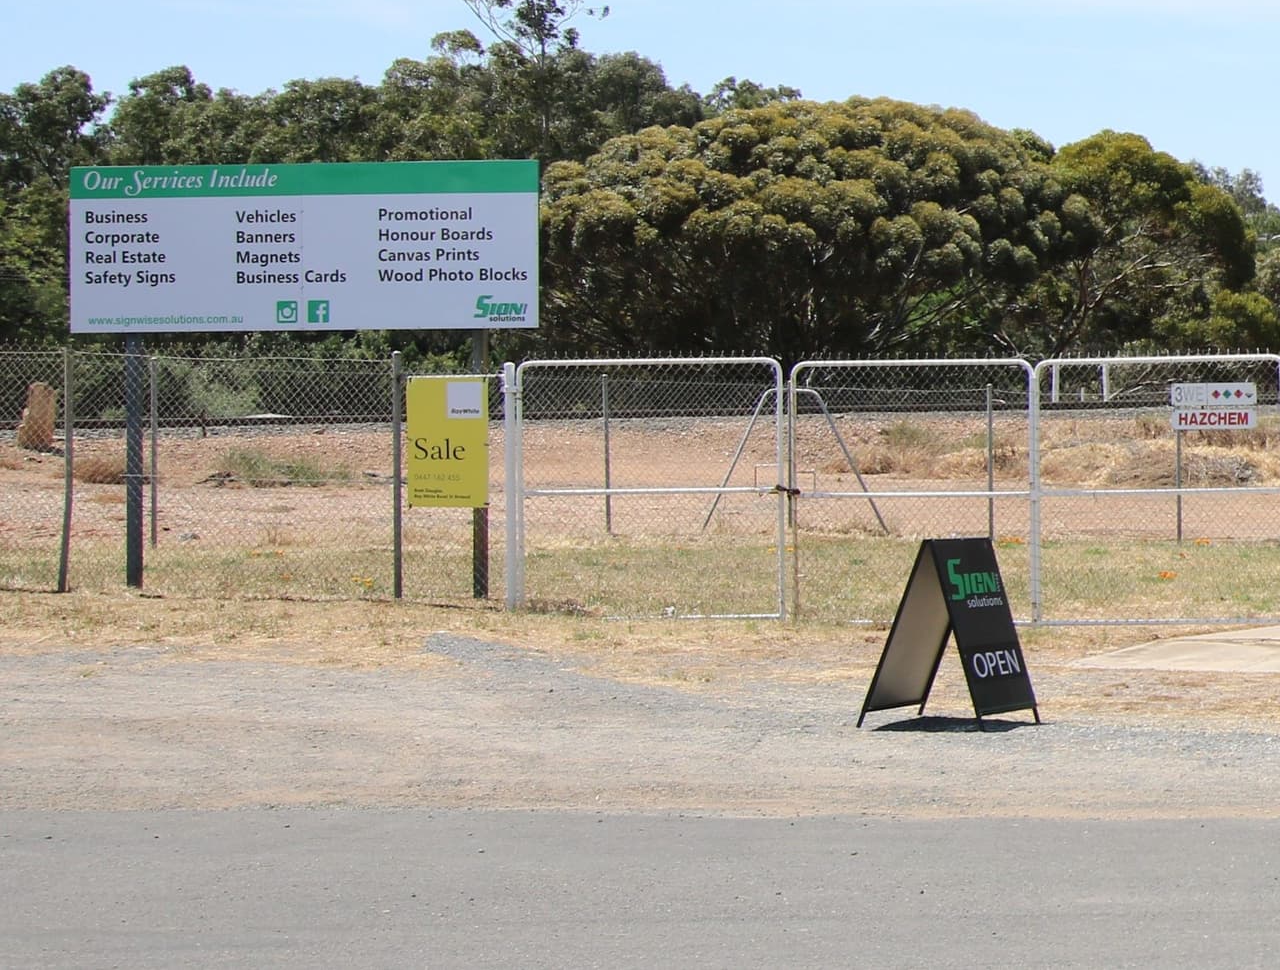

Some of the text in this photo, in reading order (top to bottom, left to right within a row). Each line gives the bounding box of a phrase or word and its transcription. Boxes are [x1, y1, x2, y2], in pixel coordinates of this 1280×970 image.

[83, 168, 278, 196] Our Services Include
[85, 211, 148, 223] Business
[236, 210, 297, 223] Vehicles
[378, 207, 472, 221] Promotional
[85, 231, 160, 247] Corporate
[236, 231, 295, 244] Banners
[378, 227, 493, 242] Honour Boards
[85, 251, 166, 264] Real Estate
[236, 251, 301, 267] Magnets
[378, 248, 480, 262] Canvas Prints
[85, 270, 176, 287] Safety Signs
[236, 269, 347, 284] Business Cards
[378, 268, 528, 282] Wood Photo Blocks
[88, 315, 244, 327] www.signwisesolutions.com.au
[489, 314, 526, 322] solutions
[1179, 412, 1249, 426] HAZCHEM
[414, 437, 465, 461] Sale
[947, 558, 998, 600] SIGN
[967, 596, 1003, 608] solutions
[973, 649, 1020, 678] OPEN
